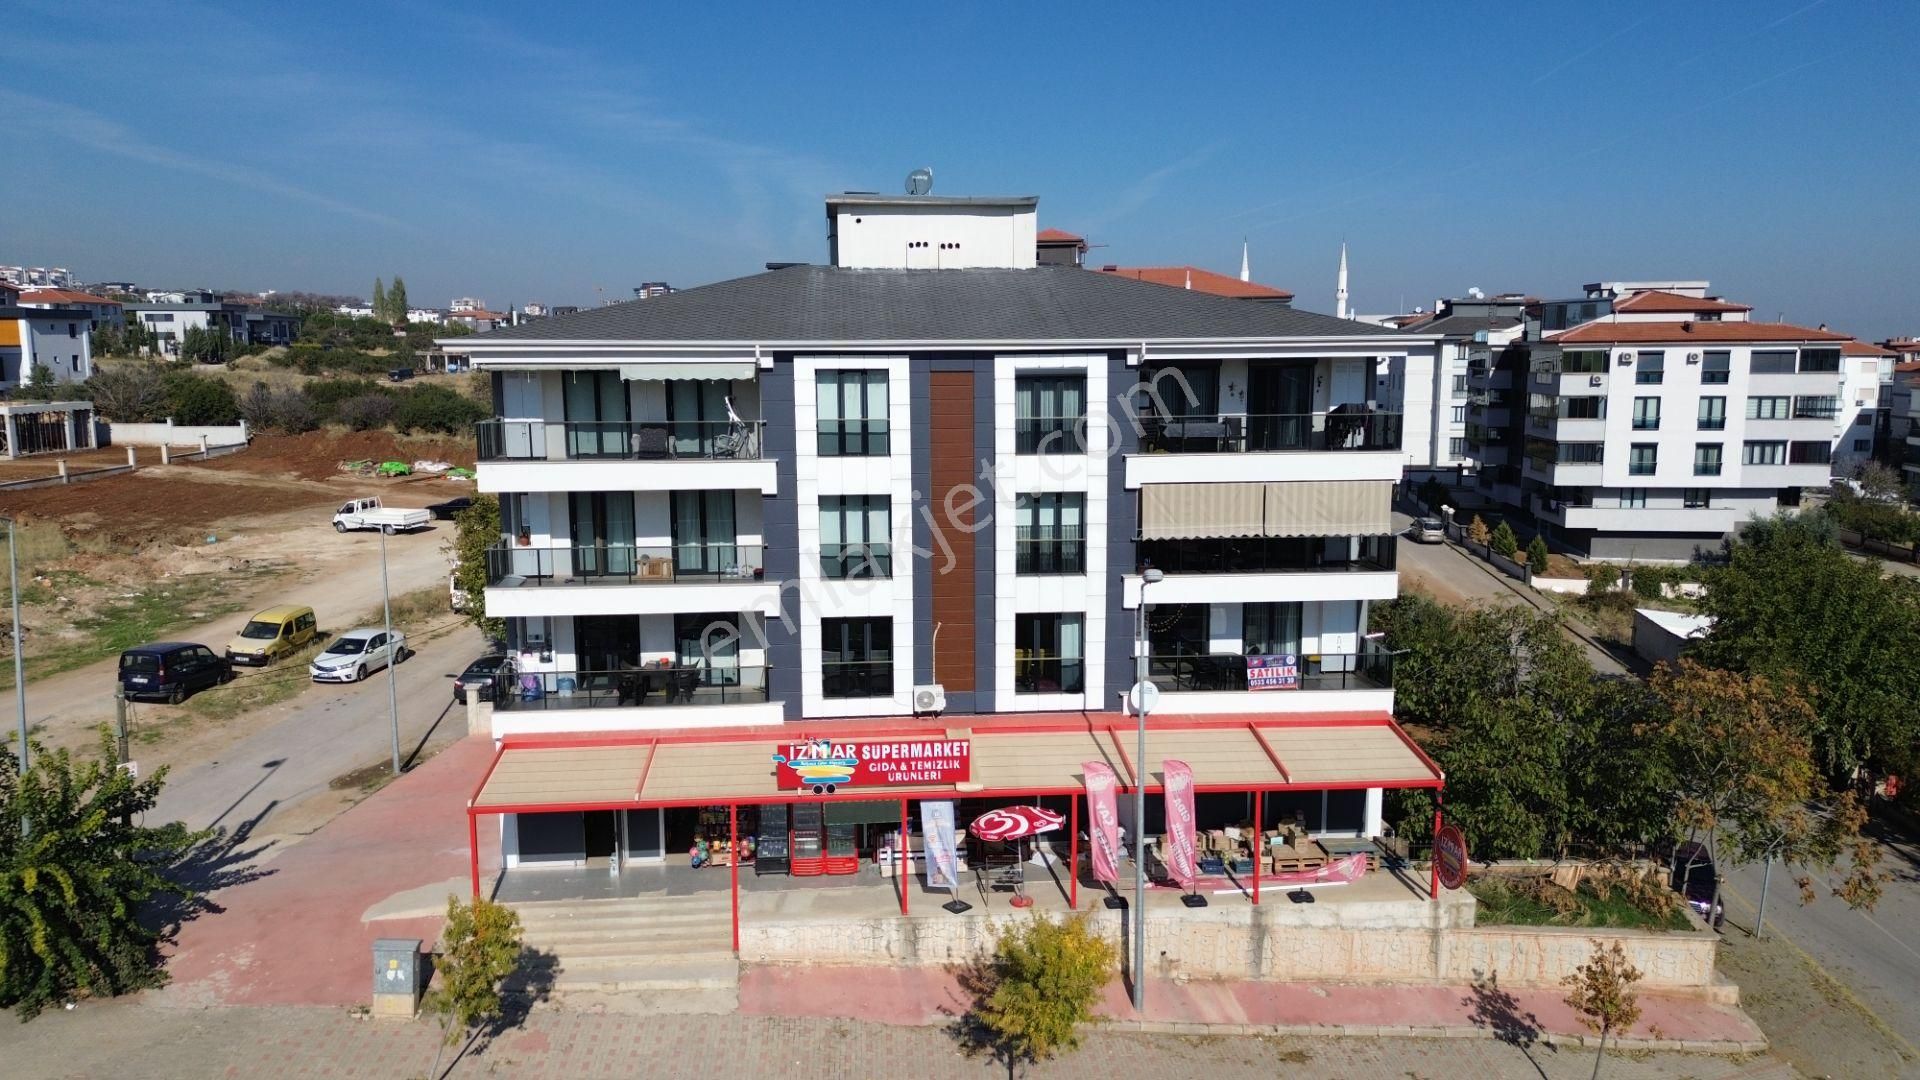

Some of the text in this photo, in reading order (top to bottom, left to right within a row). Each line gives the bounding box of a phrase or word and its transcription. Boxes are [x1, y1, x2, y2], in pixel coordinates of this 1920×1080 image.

[1250, 667, 1294, 679] SATILIK
[869, 762, 897, 773] GIDA
[900, 762, 908, 772] &
